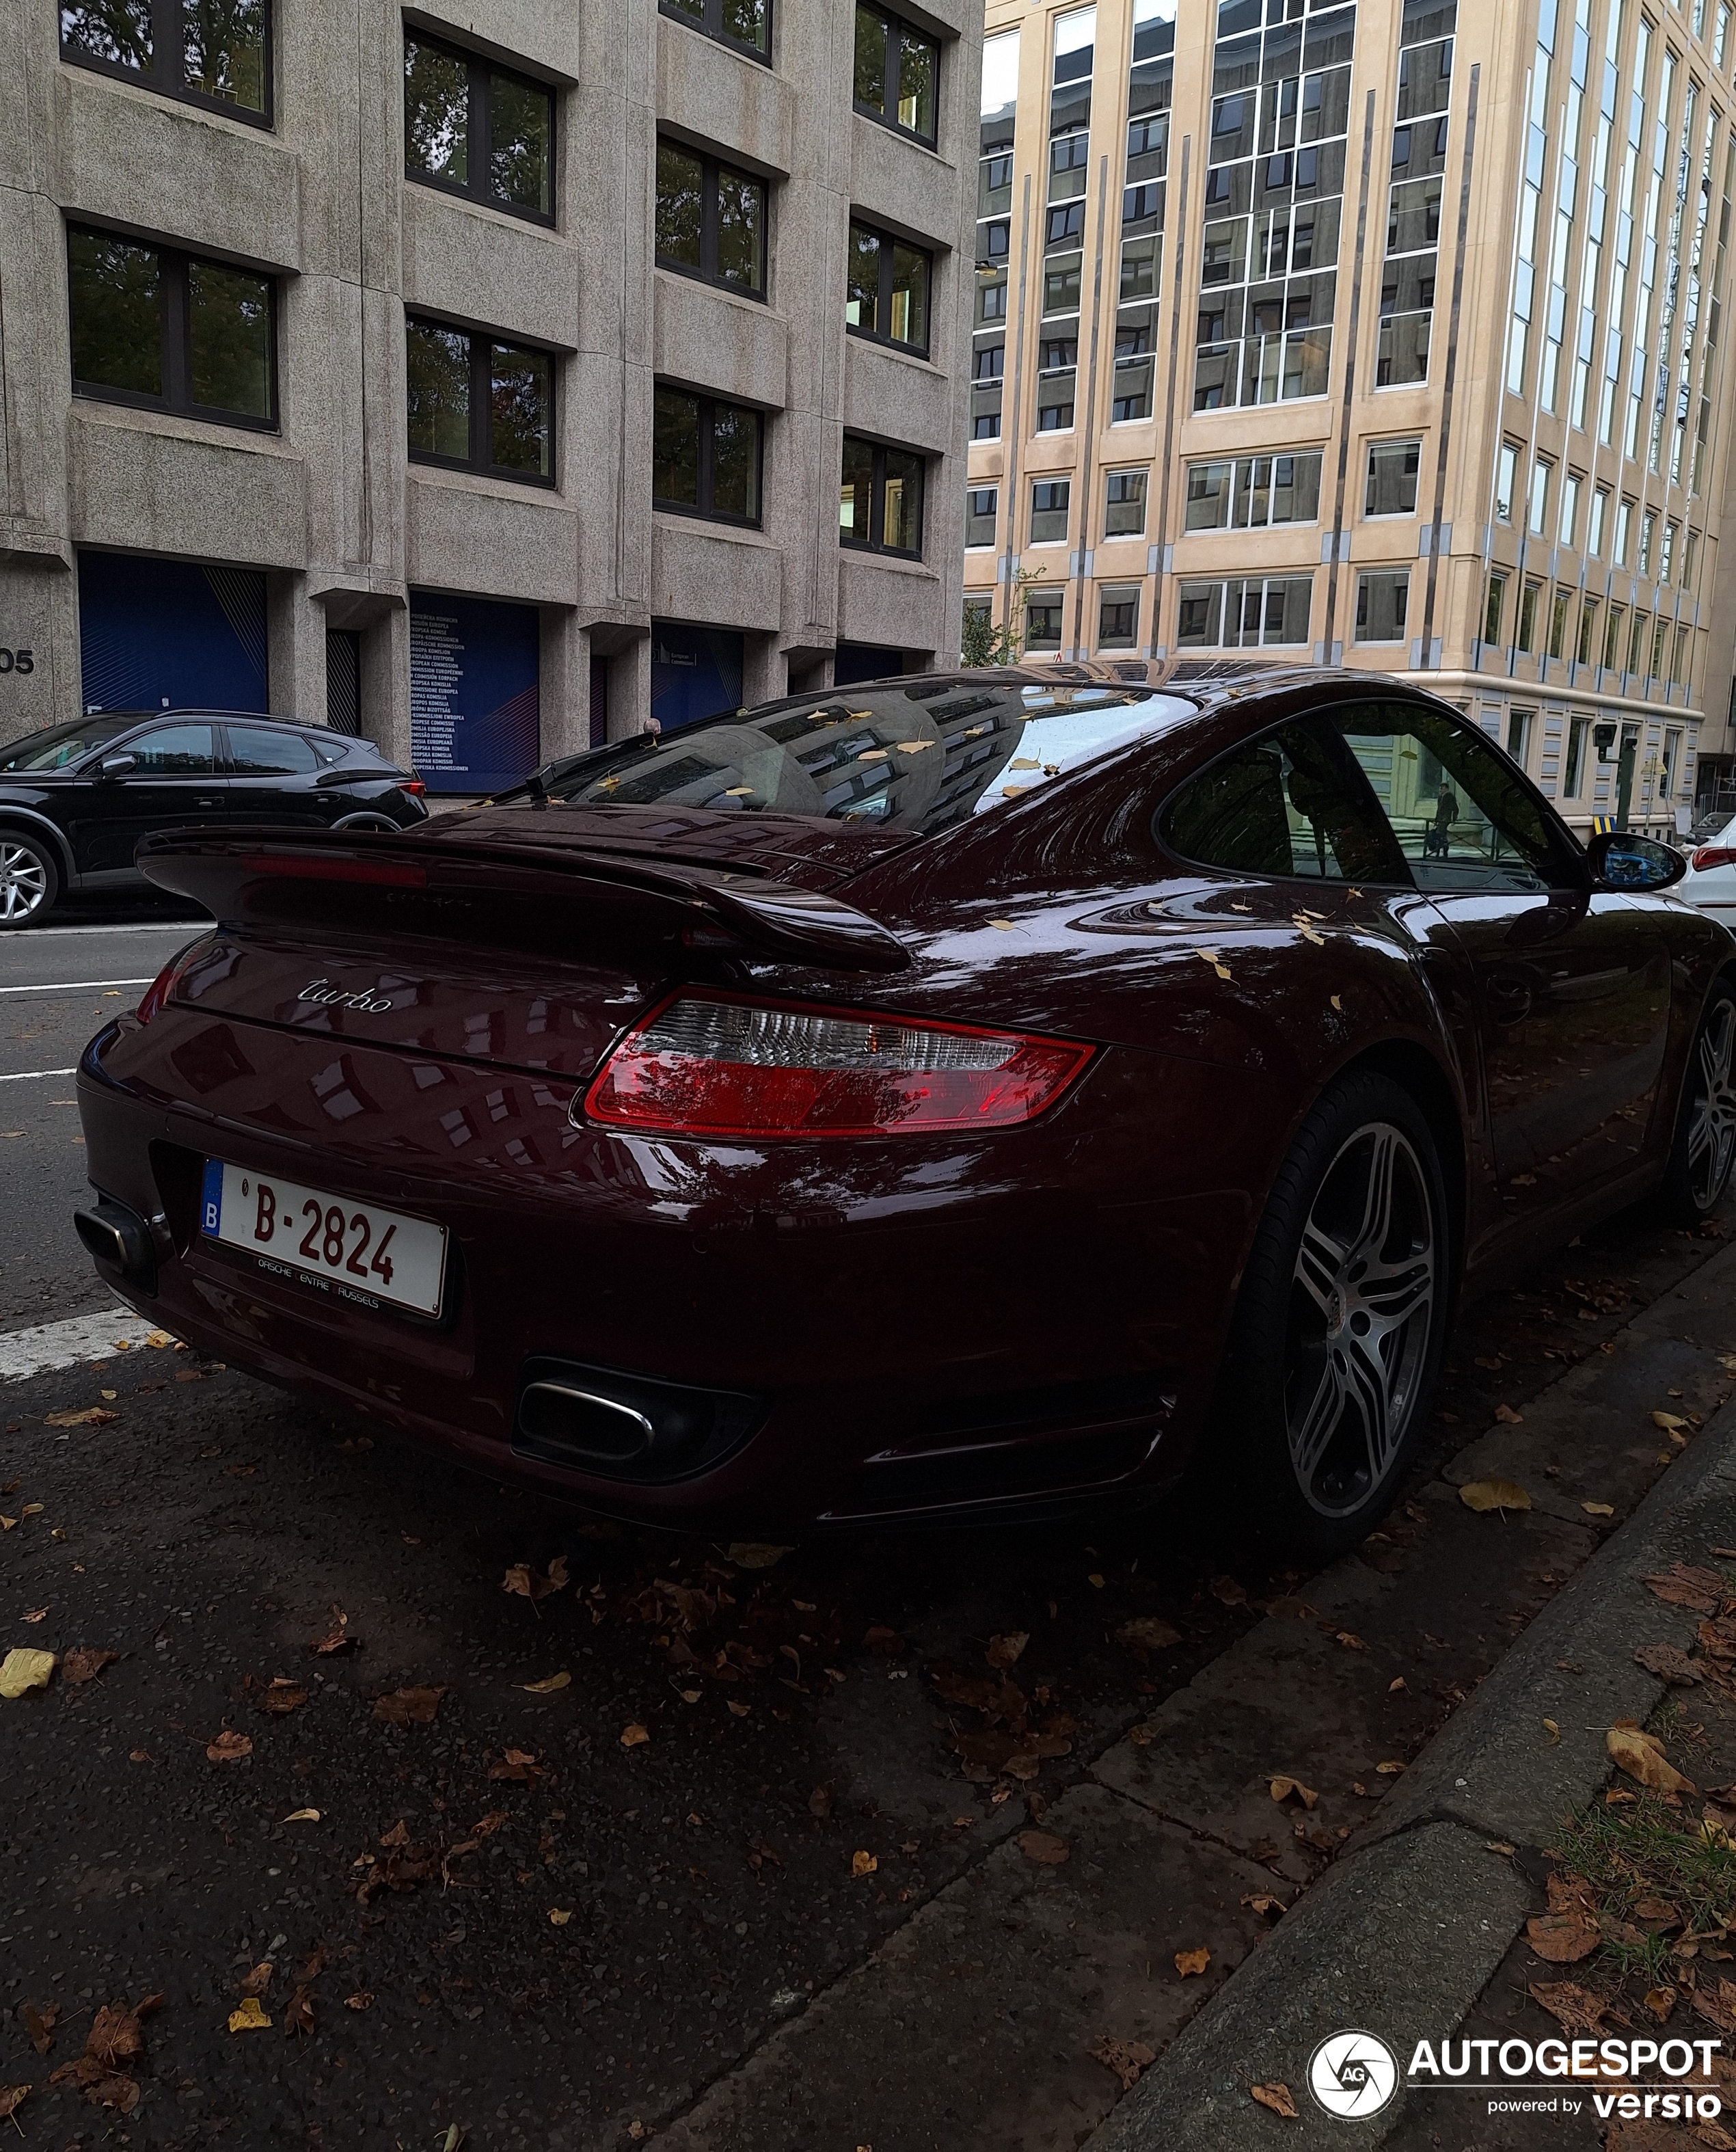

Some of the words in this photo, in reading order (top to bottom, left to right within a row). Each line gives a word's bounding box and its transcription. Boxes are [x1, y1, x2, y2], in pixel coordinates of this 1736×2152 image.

[0, 648, 34, 674] 05
[297, 978, 392, 1013] turbo
[206, 1202, 217, 1228] B
